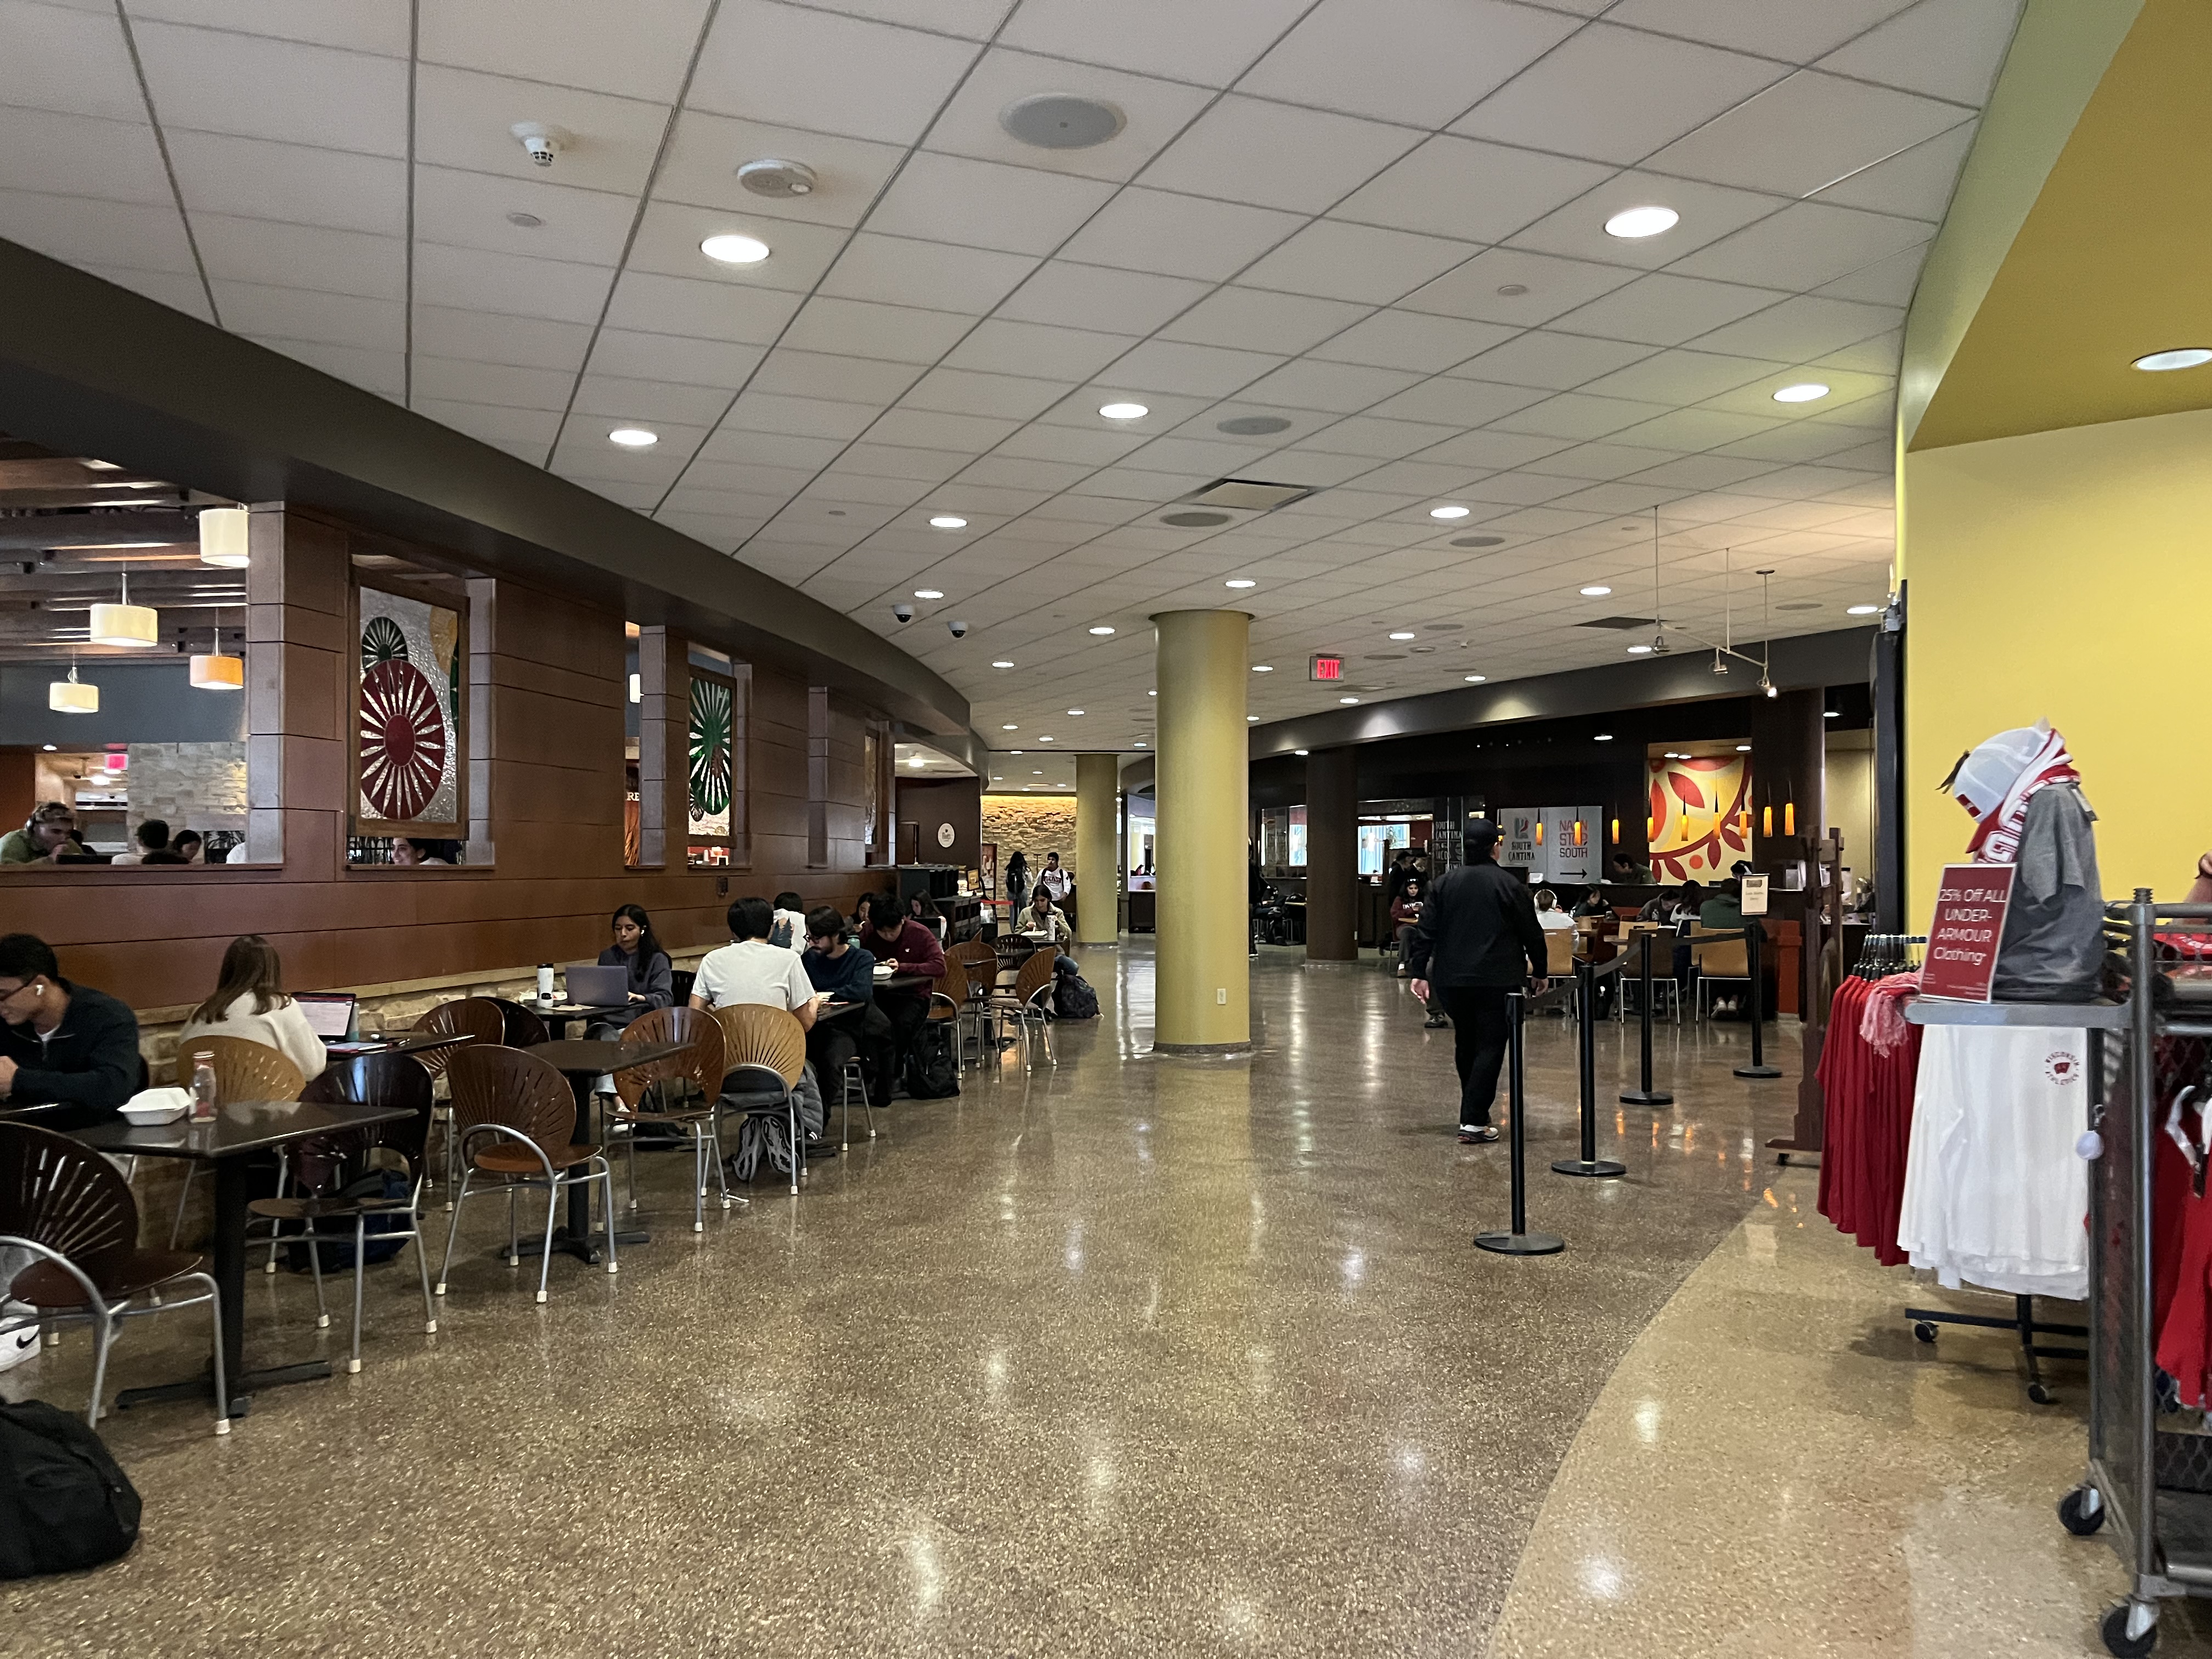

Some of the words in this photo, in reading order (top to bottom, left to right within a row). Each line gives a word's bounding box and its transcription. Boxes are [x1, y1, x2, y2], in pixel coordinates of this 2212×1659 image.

[1317, 659, 1340, 679] EXIT
[1559, 820, 1588, 831] NAN
[1560, 833, 1588, 845] STP
[1511, 842, 1531, 850] SOUTH
[1508, 852, 1535, 861] CANTINA
[1559, 848, 1588, 857] SOUTH
[1938, 889, 1962, 901] 25%
[1964, 889, 1984, 902] Off
[1983, 889, 2006, 902] ALL
[1945, 909, 1993, 922] UNDER-
[1935, 928, 1993, 943] ARMOUR
[2045, 1051, 2080, 1065] WISCONSIN
